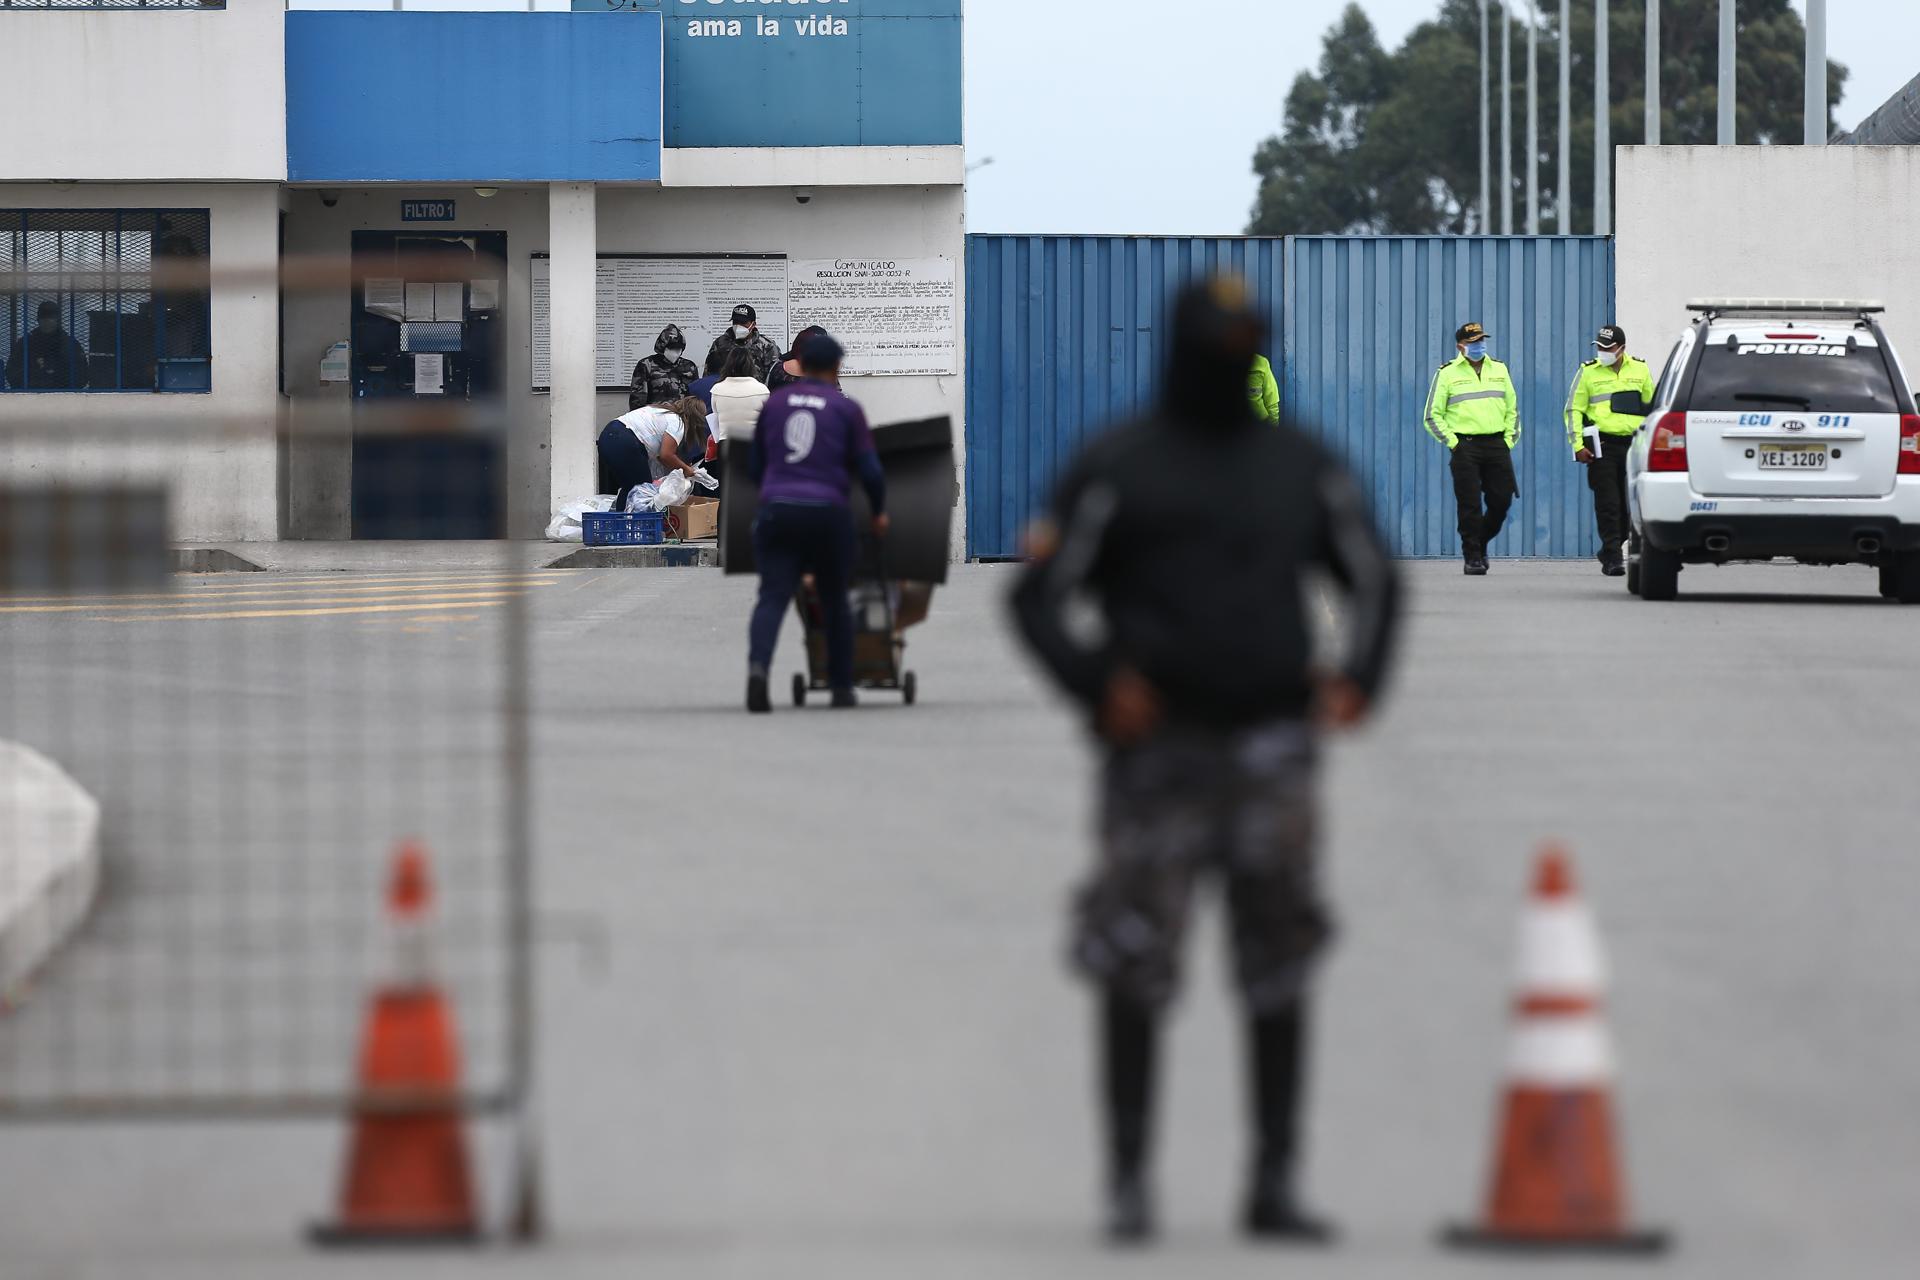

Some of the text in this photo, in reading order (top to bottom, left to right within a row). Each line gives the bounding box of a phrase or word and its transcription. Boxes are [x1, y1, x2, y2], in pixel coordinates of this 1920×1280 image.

[687, 14, 848, 37] ama la vida
[405, 203, 453, 218] FILTRO 1
[834, 259, 896, 271] COMUNICADO
[816, 270, 852, 278] RESOLUCION
[1737, 344, 1846, 357] POLICIA
[1738, 414, 1773, 427] ECU
[1817, 415, 1851, 428] 911
[784, 408, 816, 464] 9
